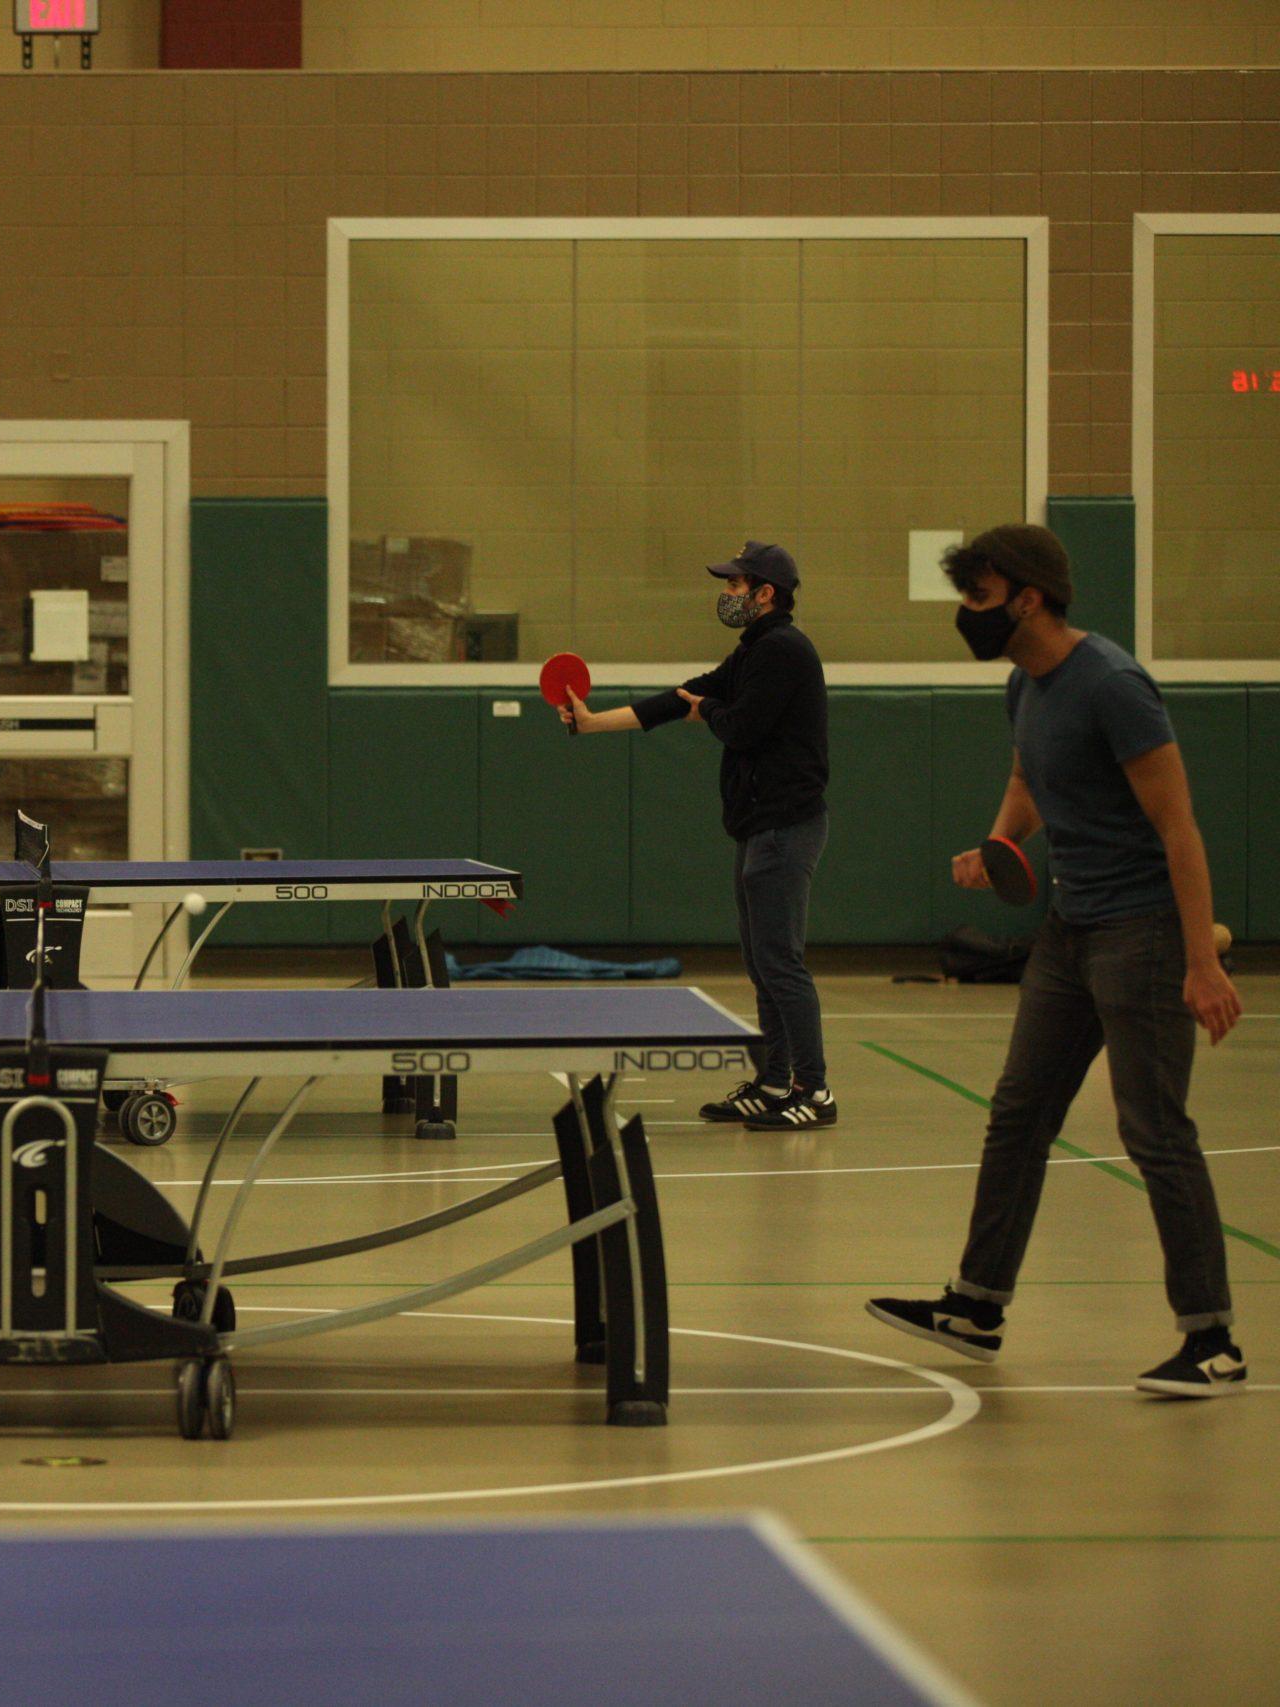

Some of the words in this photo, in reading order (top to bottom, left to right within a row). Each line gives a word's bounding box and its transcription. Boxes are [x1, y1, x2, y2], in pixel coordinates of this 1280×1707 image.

[276, 885, 328, 900] 500
[422, 884, 511, 899] INDOOR
[5, 898, 35, 912] DSI
[392, 1052, 470, 1072] 500
[614, 1050, 746, 1071] INDOOR
